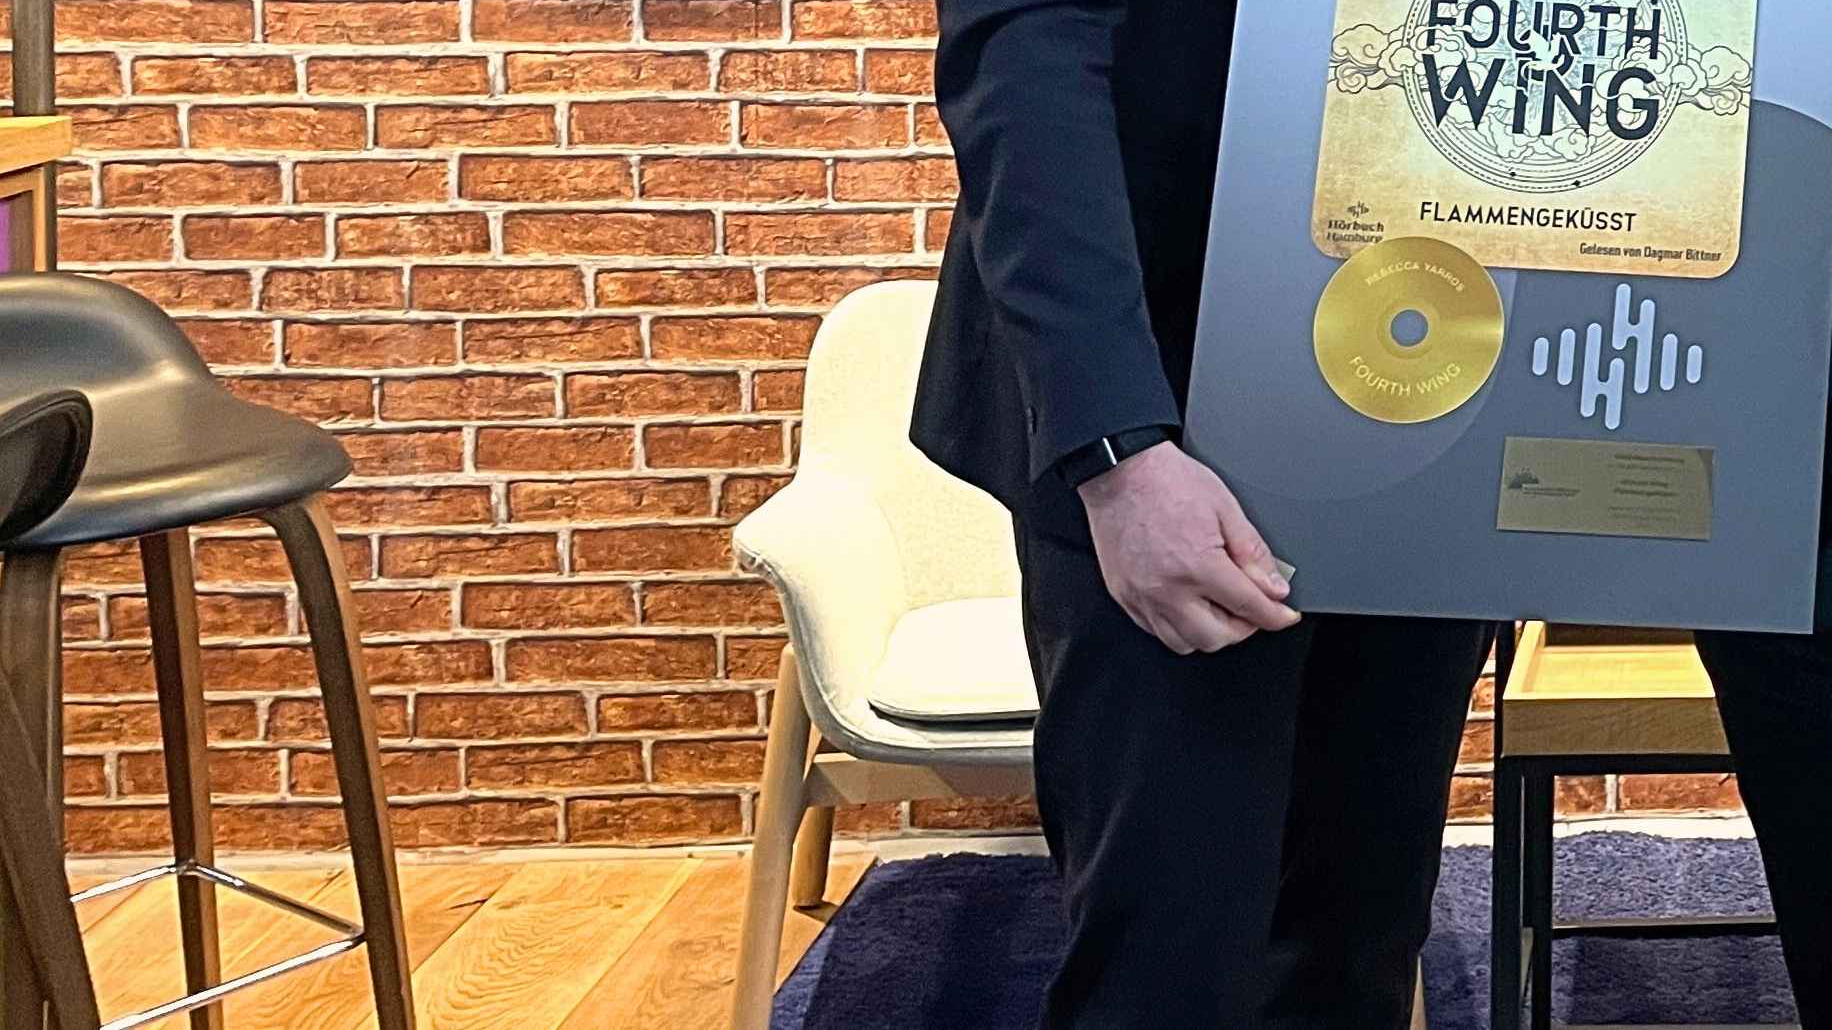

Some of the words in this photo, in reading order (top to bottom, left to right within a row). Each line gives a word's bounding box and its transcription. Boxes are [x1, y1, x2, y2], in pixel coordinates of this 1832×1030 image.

[1421, 53, 1660, 141] WING
[1327, 218, 1385, 233] Hörbuch
[1419, 201, 1637, 232] FLAMMENGEKÜSST
[1579, 242, 1621, 256] Gelesen
[1623, 246, 1642, 258] von
[1643, 246, 1683, 263] Dagmar
[1685, 248, 1722, 262] Bittner
[1349, 354, 1412, 398] FOURTH
[1416, 361, 1462, 397] WING
